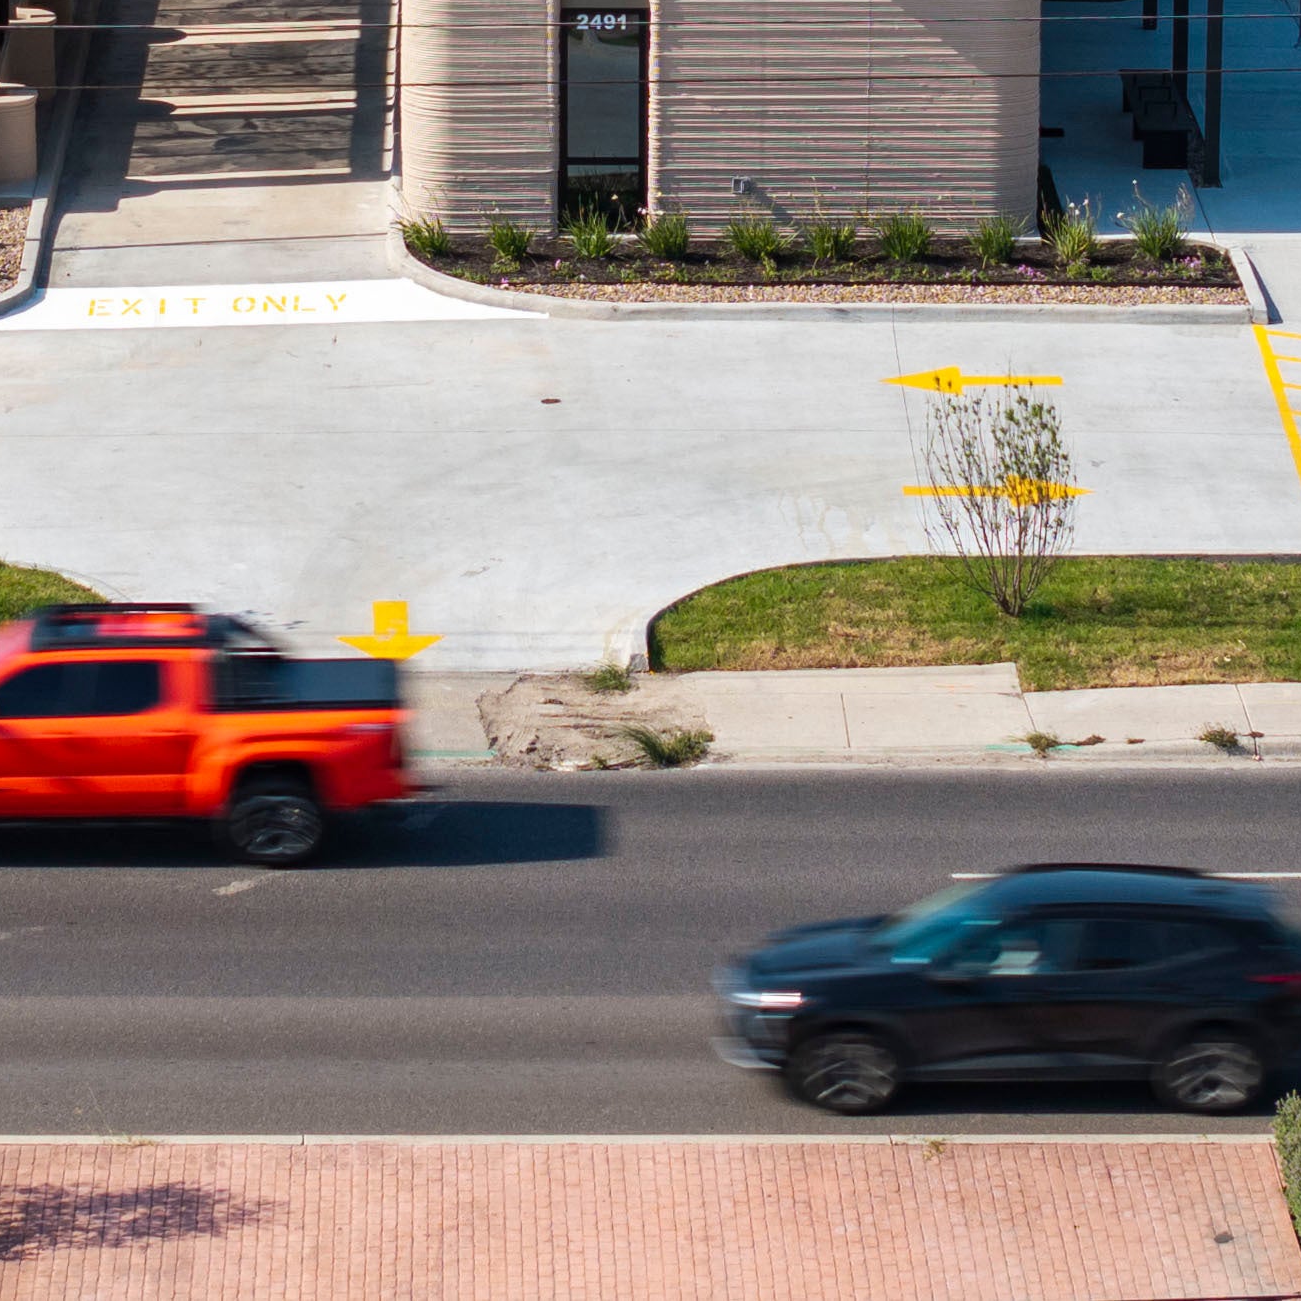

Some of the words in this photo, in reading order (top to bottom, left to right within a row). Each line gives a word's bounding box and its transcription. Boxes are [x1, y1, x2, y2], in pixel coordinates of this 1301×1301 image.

[576, 13, 627, 30] 2491
[87, 297, 207, 317] EXIT
[232, 293, 348, 315] ONLY
